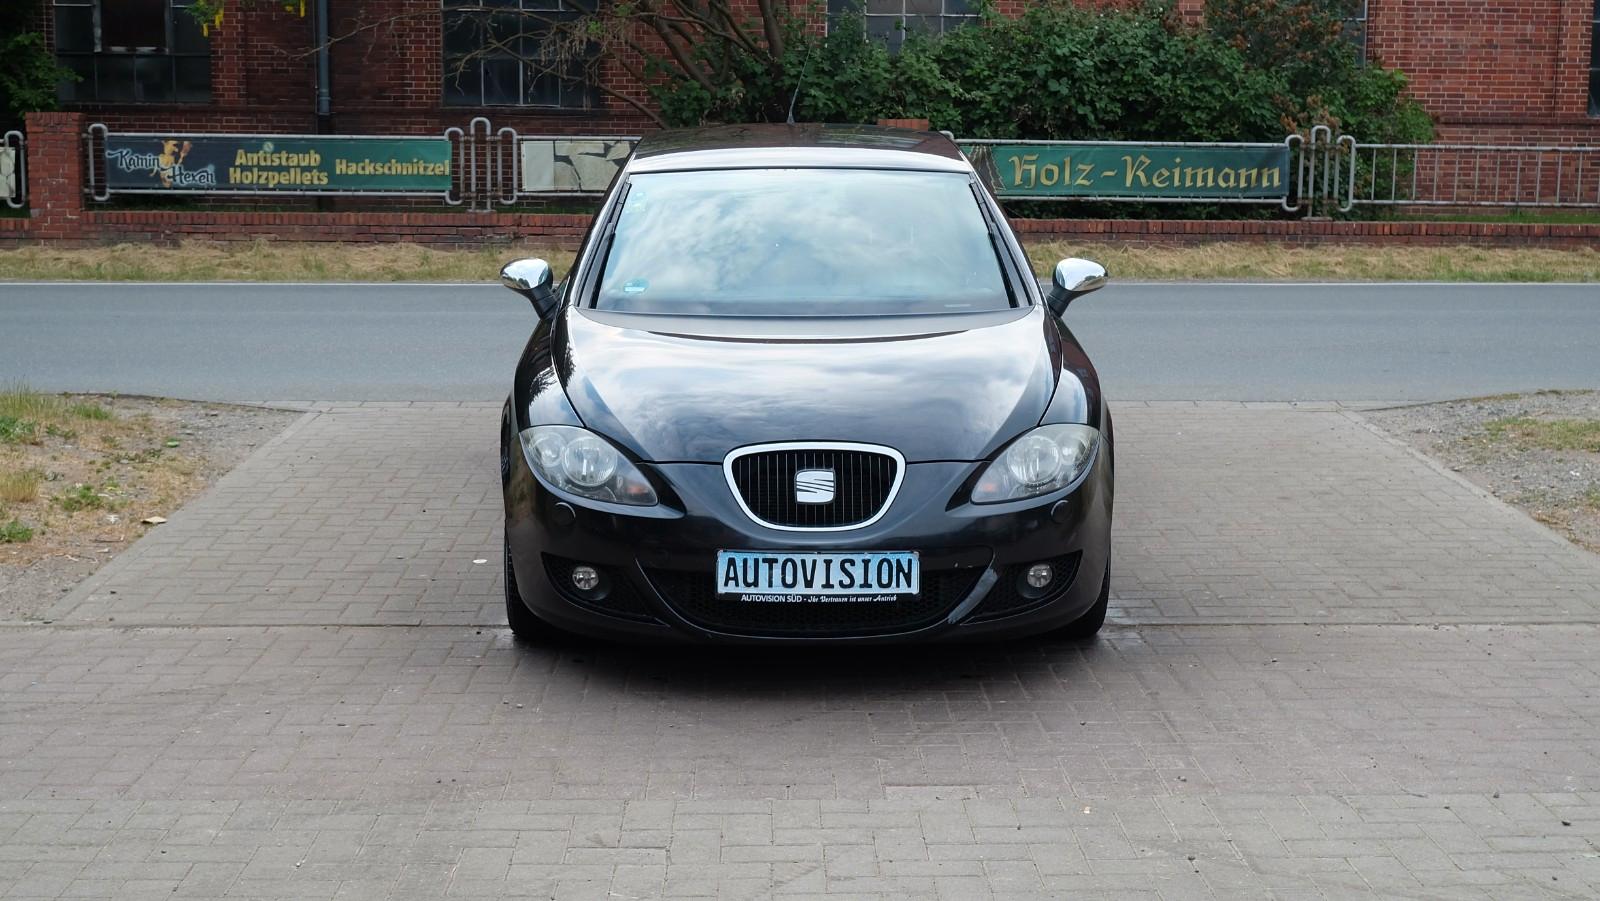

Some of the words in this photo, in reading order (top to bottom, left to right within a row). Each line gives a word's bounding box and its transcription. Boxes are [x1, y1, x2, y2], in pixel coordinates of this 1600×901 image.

[106, 148, 161, 172] Kamin
[235, 149, 321, 167] Antistaub
[335, 158, 449, 176] Hackschnitzel
[160, 165, 216, 185] Hexen
[229, 167, 329, 188] Holzpellets
[1009, 154, 1095, 188] Holz
[1122, 155, 1282, 188] Reimann
[724, 557, 913, 589] AUTOVISION
[741, 594, 785, 602] AUTOVISION
[786, 593, 802, 602] SÜD
